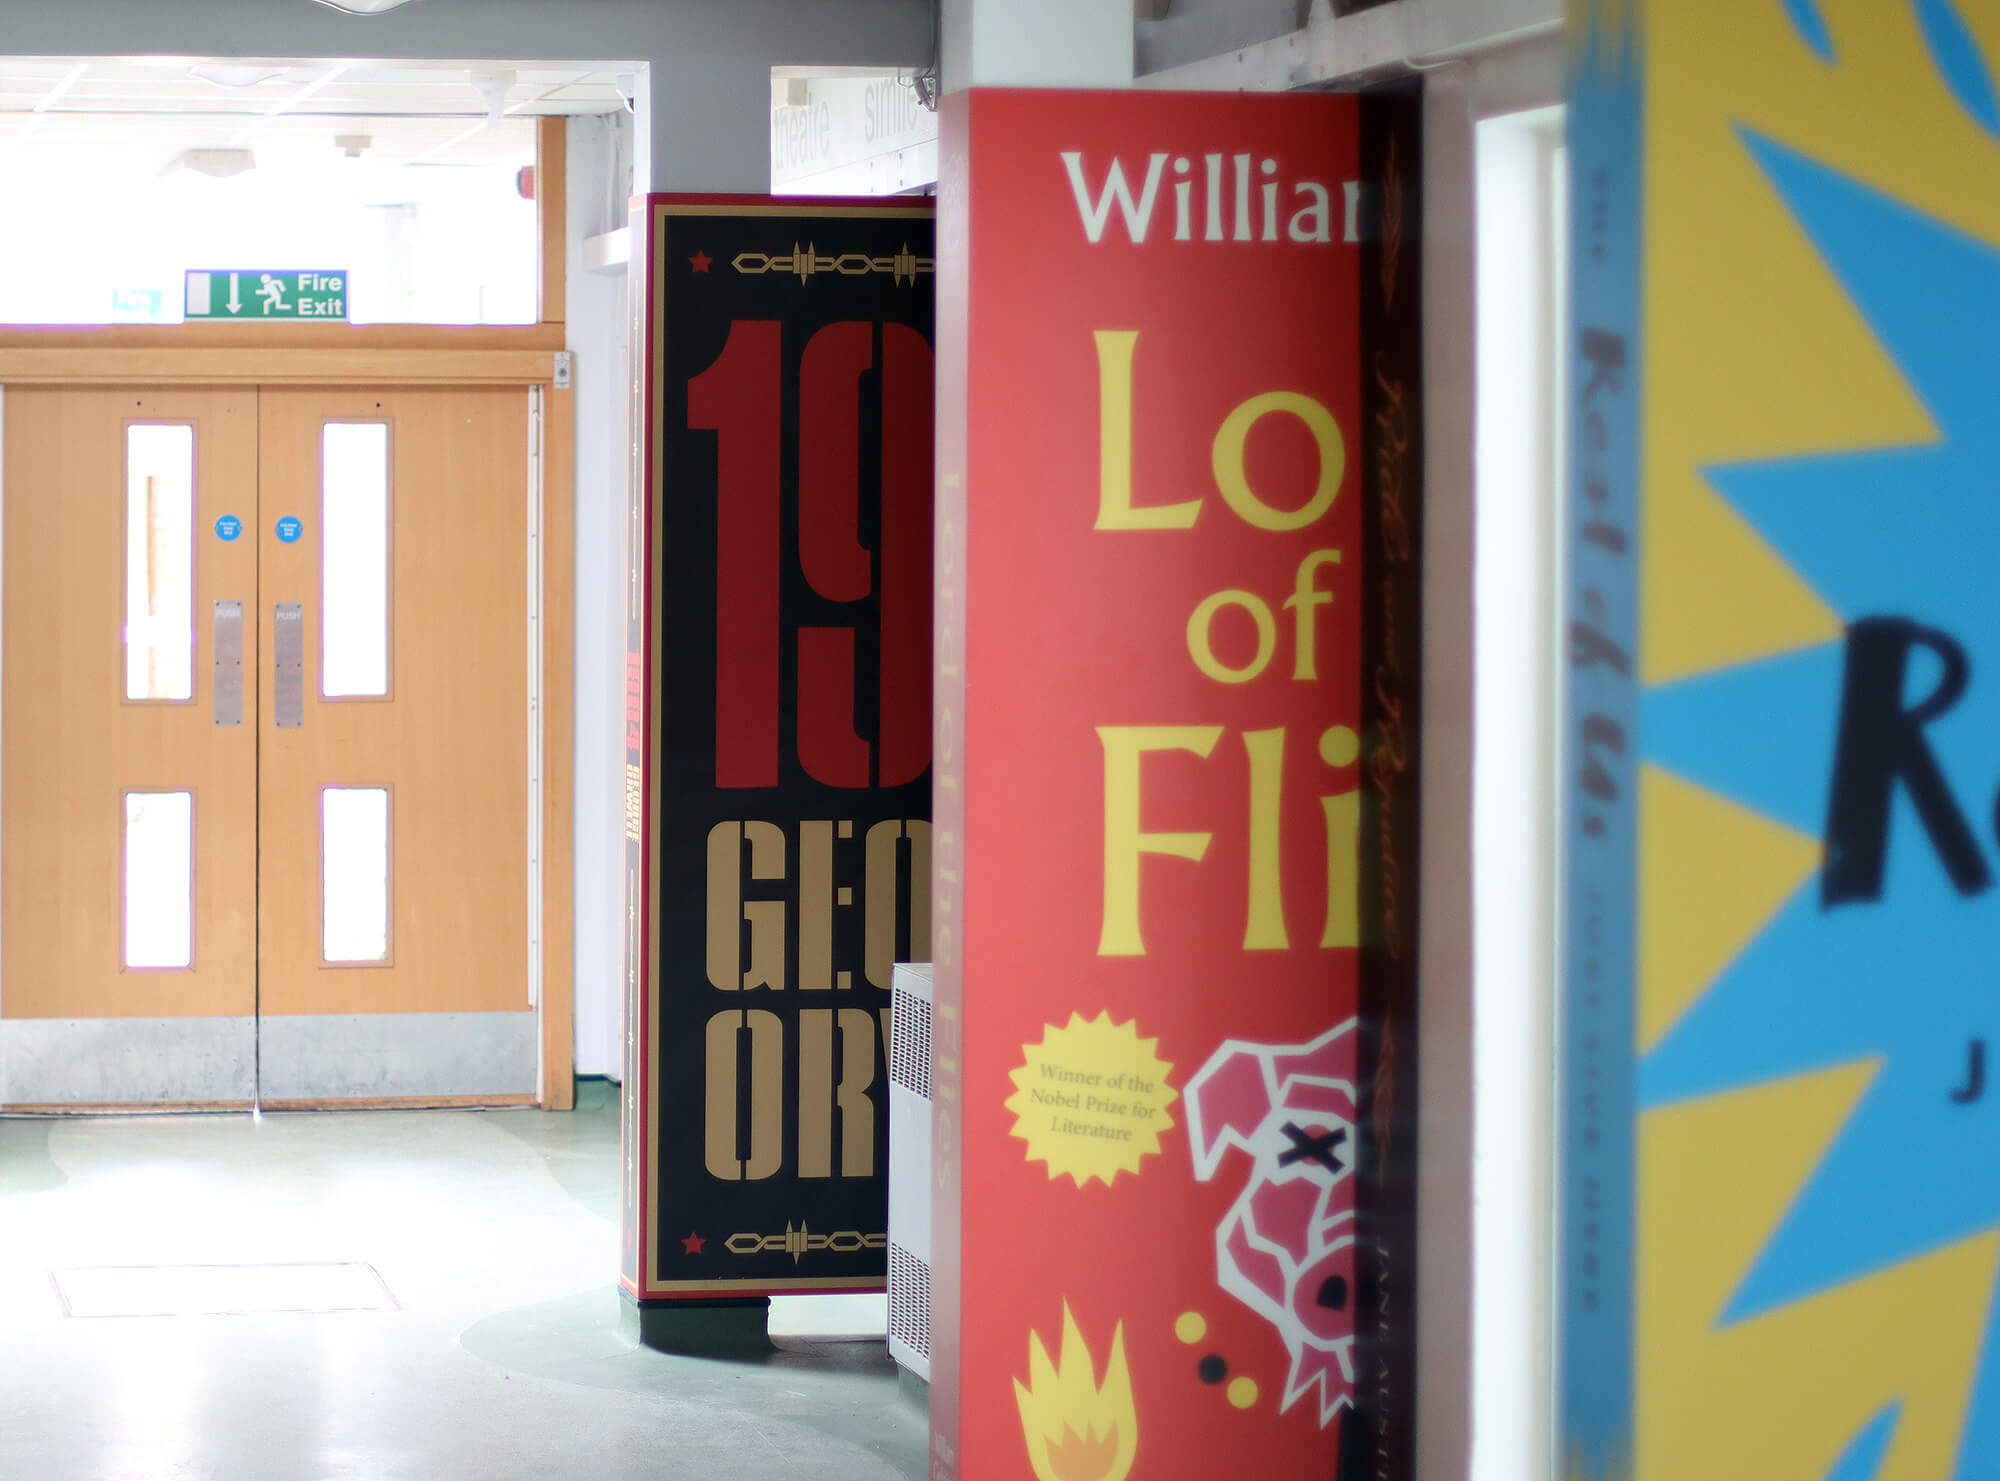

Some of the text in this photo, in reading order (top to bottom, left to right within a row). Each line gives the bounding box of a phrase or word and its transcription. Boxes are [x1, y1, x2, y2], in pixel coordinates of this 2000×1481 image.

[297, 274, 343, 291] Fire
[297, 298, 343, 316] Exit
[1093, 330, 1346, 531] Lo
[1186, 549, 1341, 684] of
[1040, 1064, 1155, 1093] Winner of the
[705, 1008, 893, 1181] OR
[1030, 1088, 1157, 1120] Nobel Prize for
[1051, 1116, 1132, 1142] Literature
